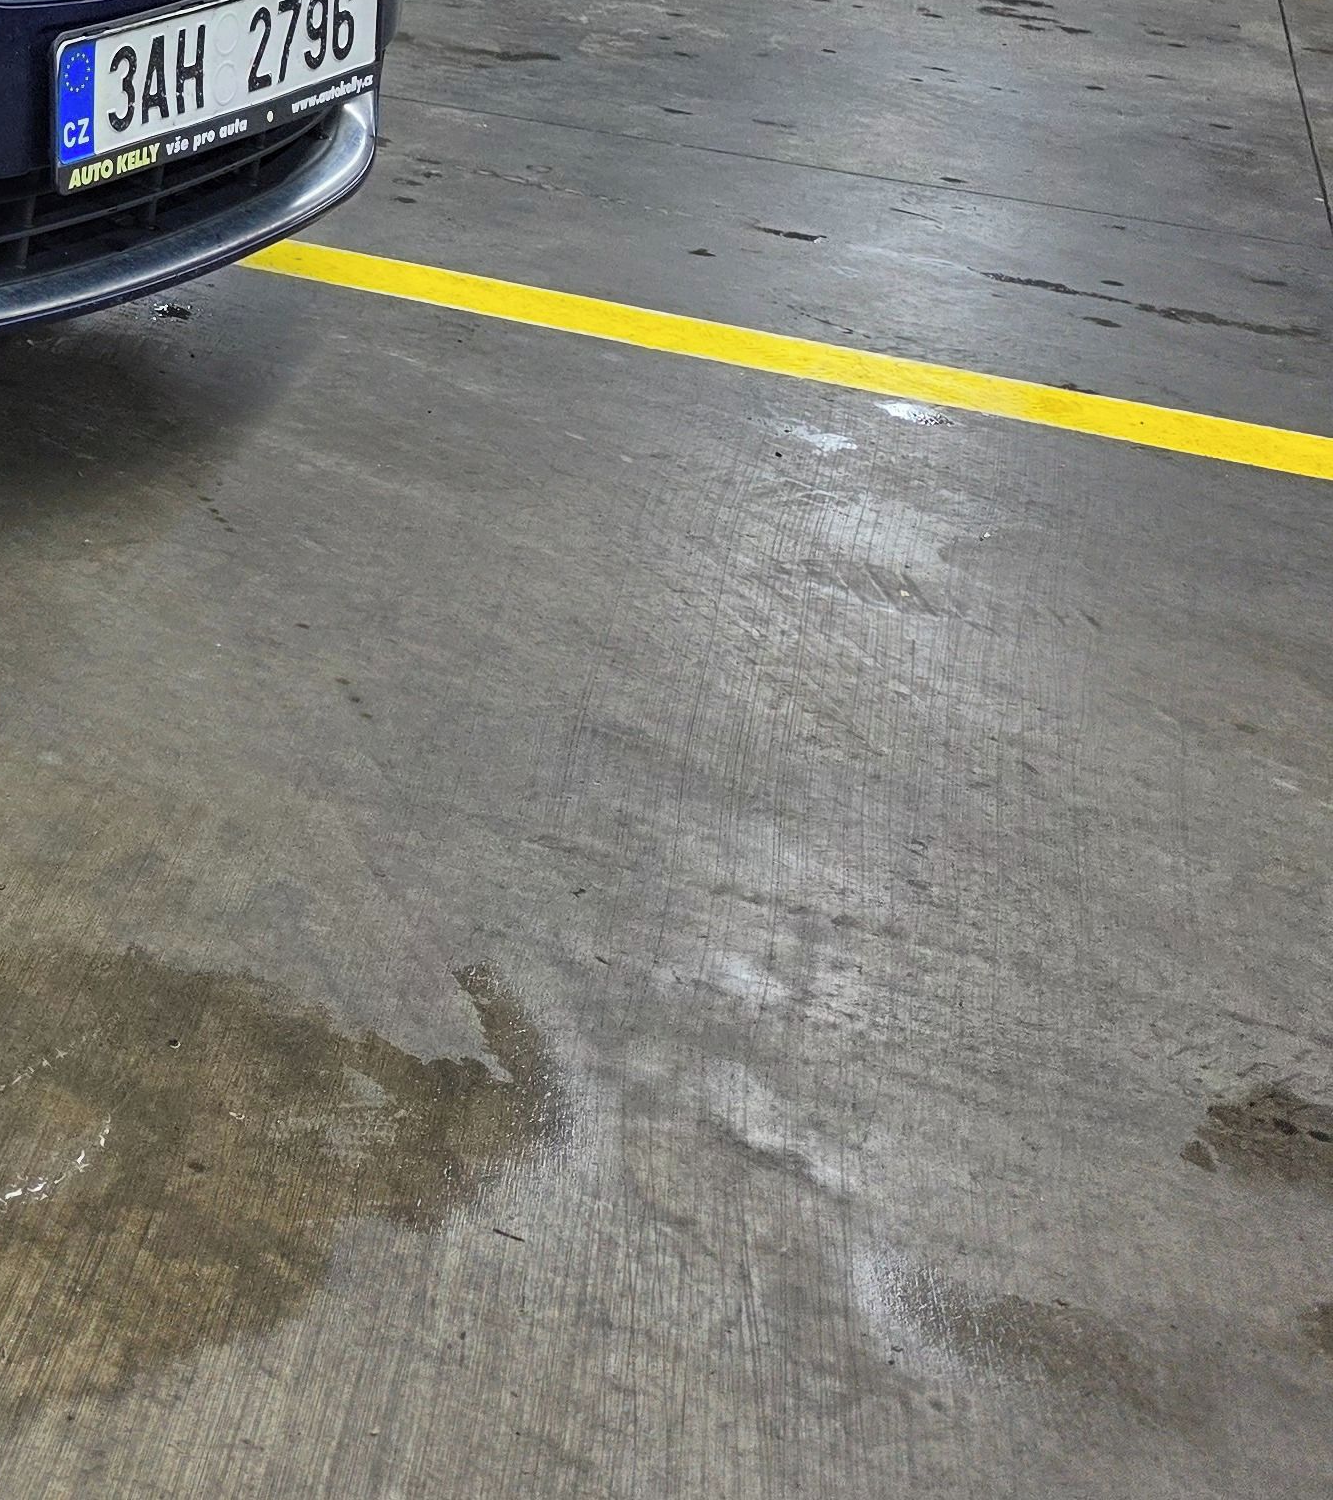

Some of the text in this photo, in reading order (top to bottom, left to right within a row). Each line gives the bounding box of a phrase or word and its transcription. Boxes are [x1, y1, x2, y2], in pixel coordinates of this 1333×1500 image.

[62, 117, 91, 149] CZ
[68, 73, 374, 190] AUTO KELLY vše pro auta www.autokelly.cz
[107, 23, 206, 133] 3AH
